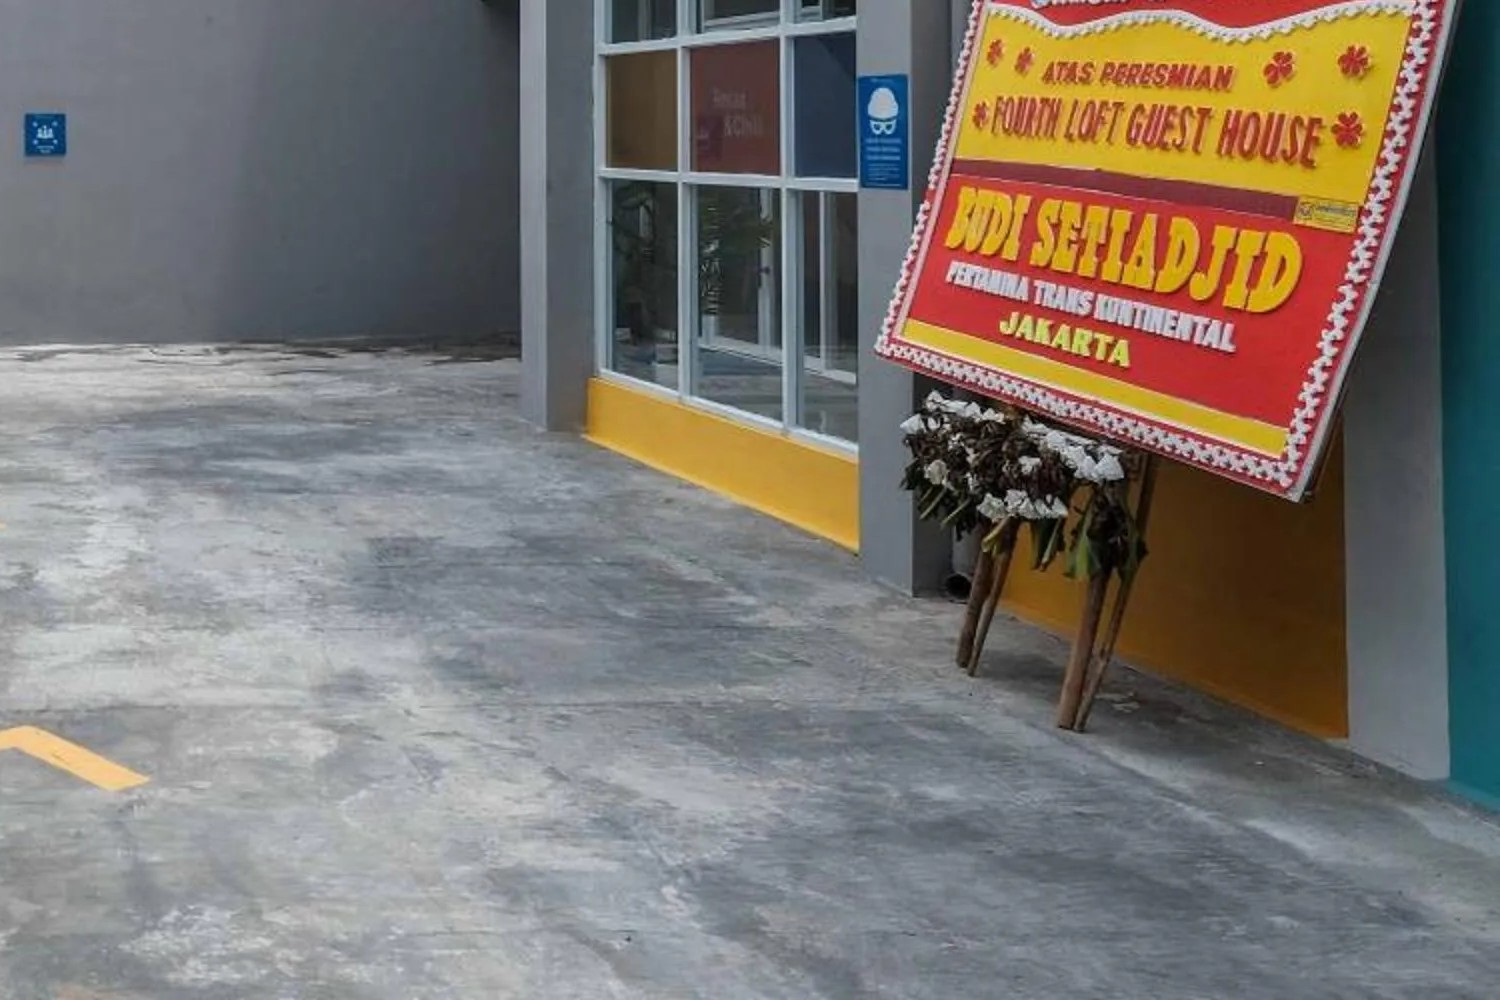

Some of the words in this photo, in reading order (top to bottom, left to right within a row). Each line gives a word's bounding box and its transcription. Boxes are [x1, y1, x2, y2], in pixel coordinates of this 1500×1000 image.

[1041, 60, 1095, 86] ATAS
[1100, 62, 1235, 92] PERESMIAN
[992, 96, 1061, 141] FOURTH
[1064, 99, 1126, 146] LOFT
[1126, 103, 1214, 155] GUEST
[1217, 108, 1324, 169] HOUSE
[945, 186, 1032, 262] BUDI
[1030, 198, 1304, 314] SETIADJID
[945, 259, 1030, 302] PERTAMINA
[1033, 279, 1096, 318] TRANS
[999, 311, 1132, 368] JAKARTA
